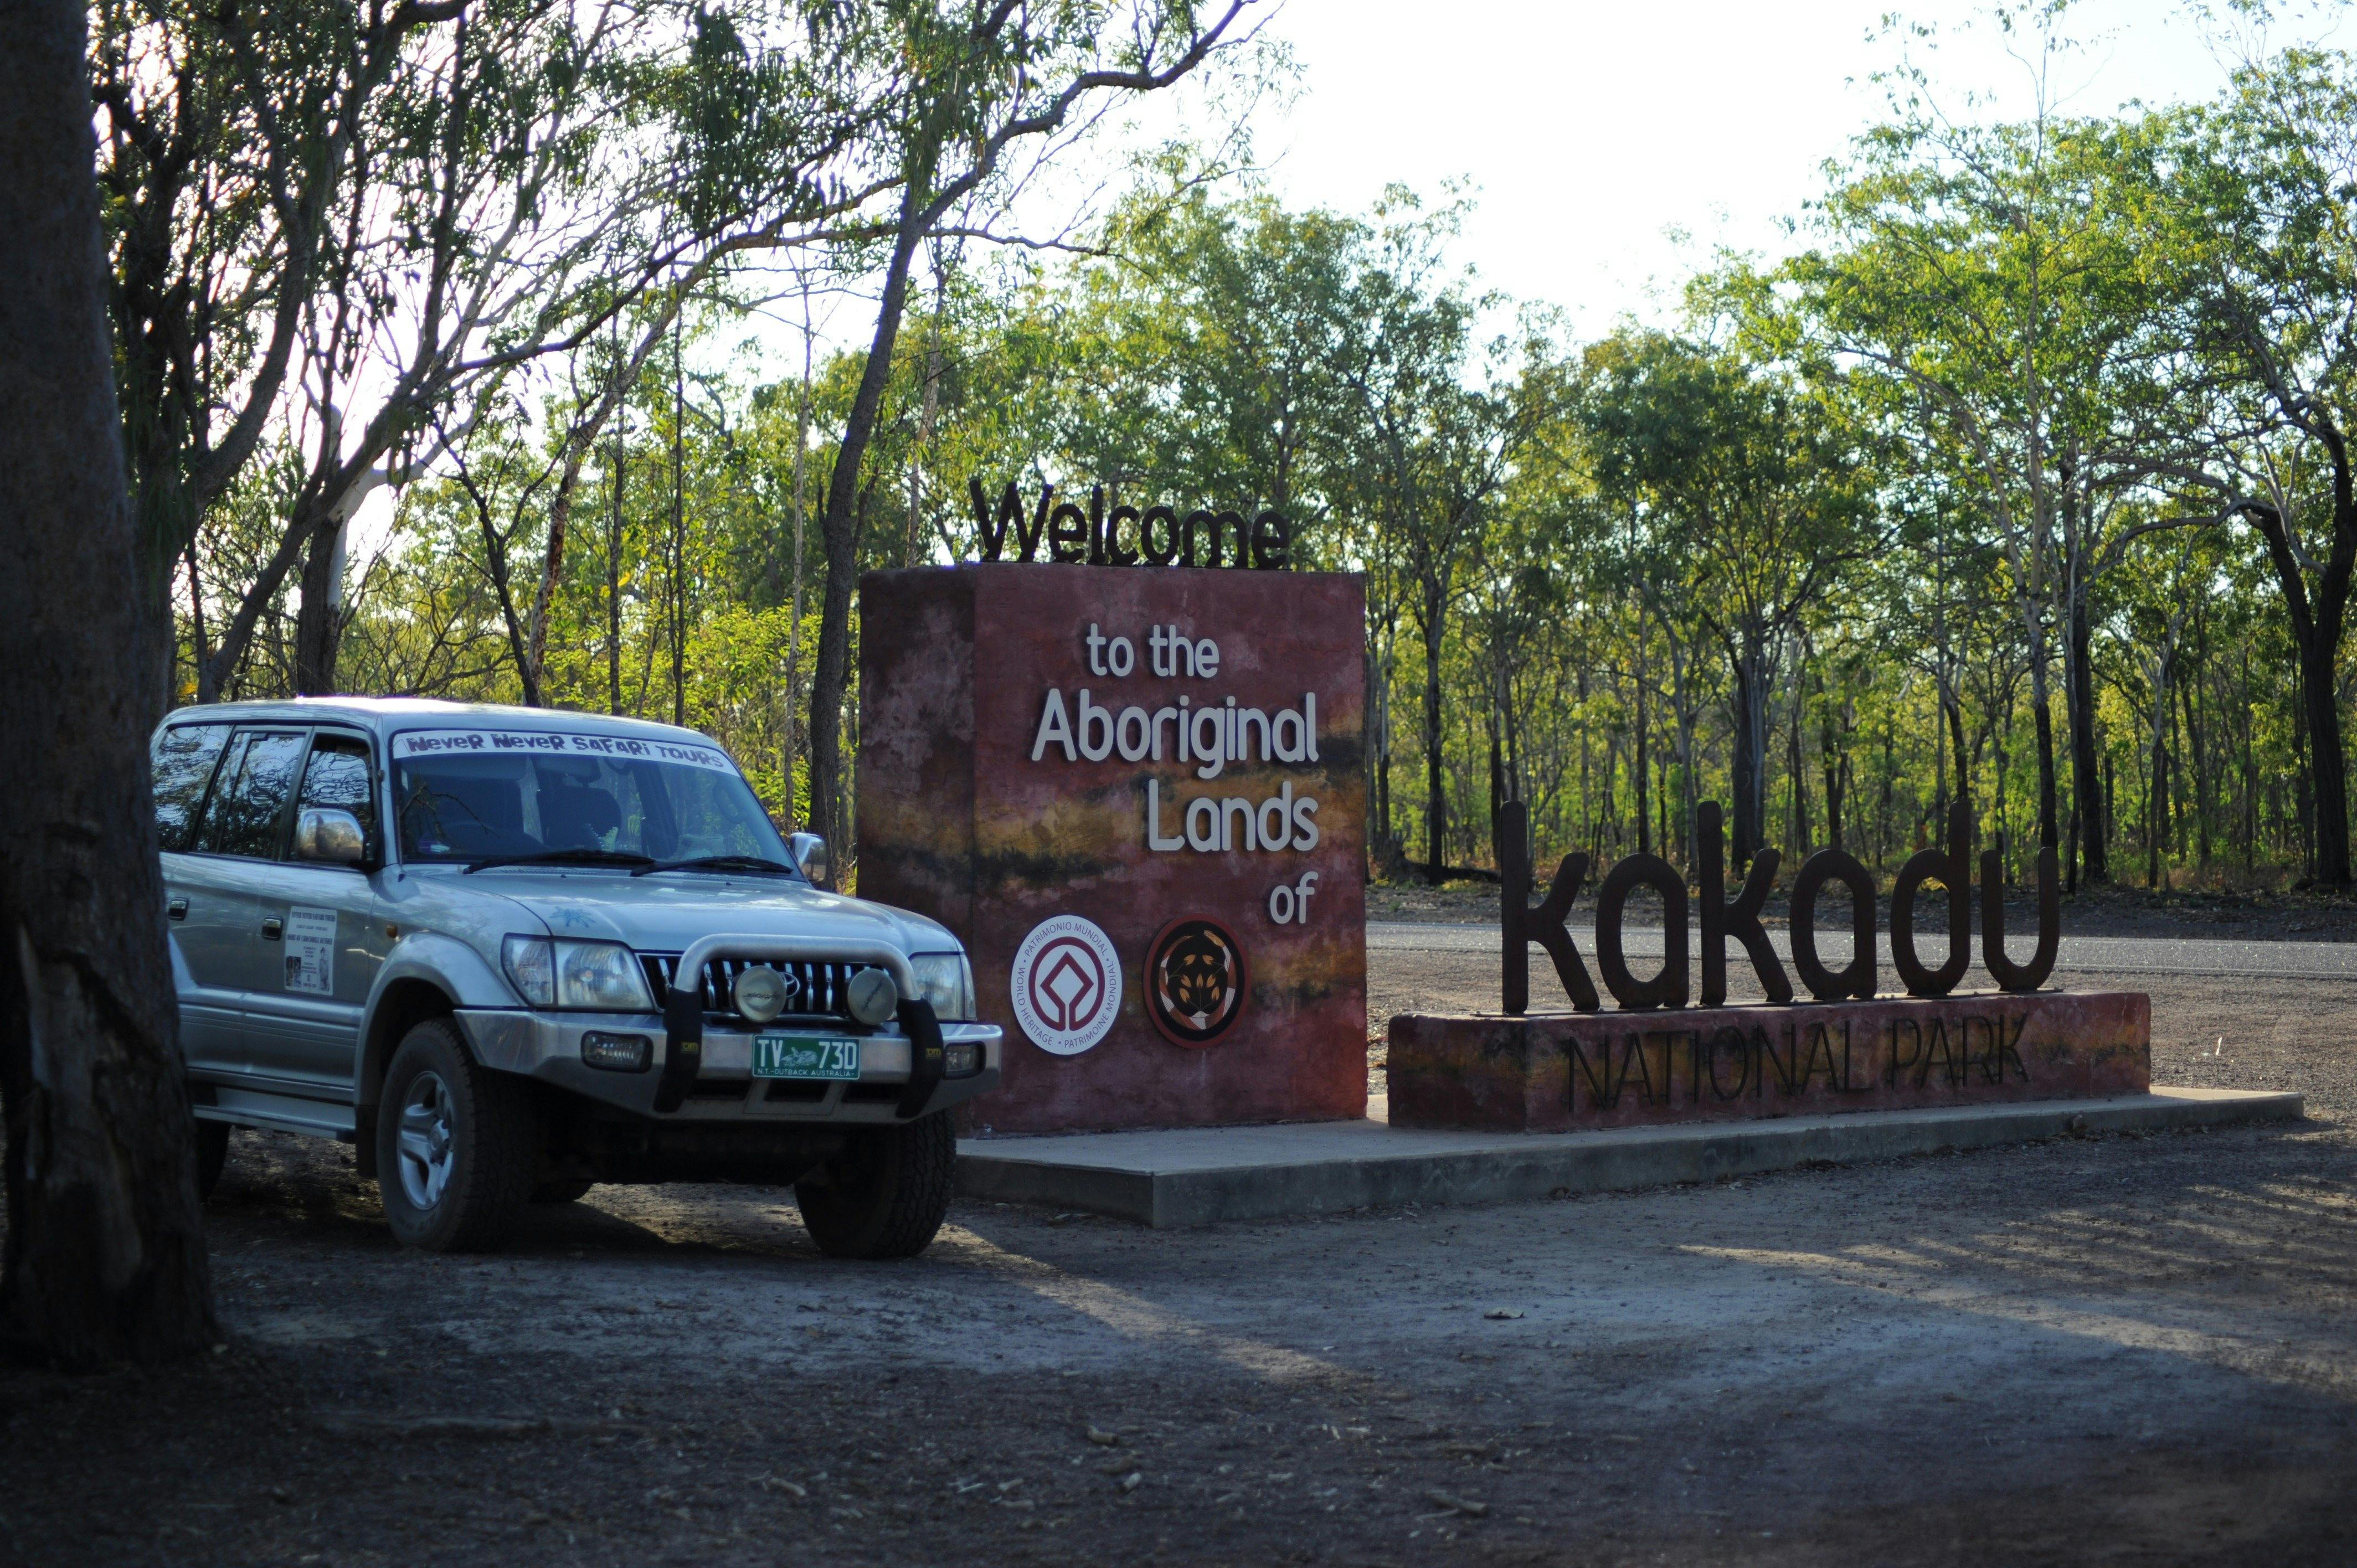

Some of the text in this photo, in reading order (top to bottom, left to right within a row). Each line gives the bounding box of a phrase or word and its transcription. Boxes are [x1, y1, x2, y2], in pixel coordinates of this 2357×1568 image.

[969, 479, 1289, 569] Welcome
[1087, 623, 1219, 678] to the
[1031, 688, 1319, 779] Aboriginal
[1149, 778, 1319, 852] Lands
[1270, 871, 1319, 924] of
[1501, 800, 2060, 1015] kakadu
[1025, 921, 1108, 957] PATRIMONIO MUNDIAL
[1017, 967, 1053, 1045] WORLD HERITAGE
[1064, 961, 1116, 1048] PATRIMOINE MONDIAL
[758, 1039, 783, 1067] TV
[1569, 1010, 2030, 1112] NATIONAL PARK
